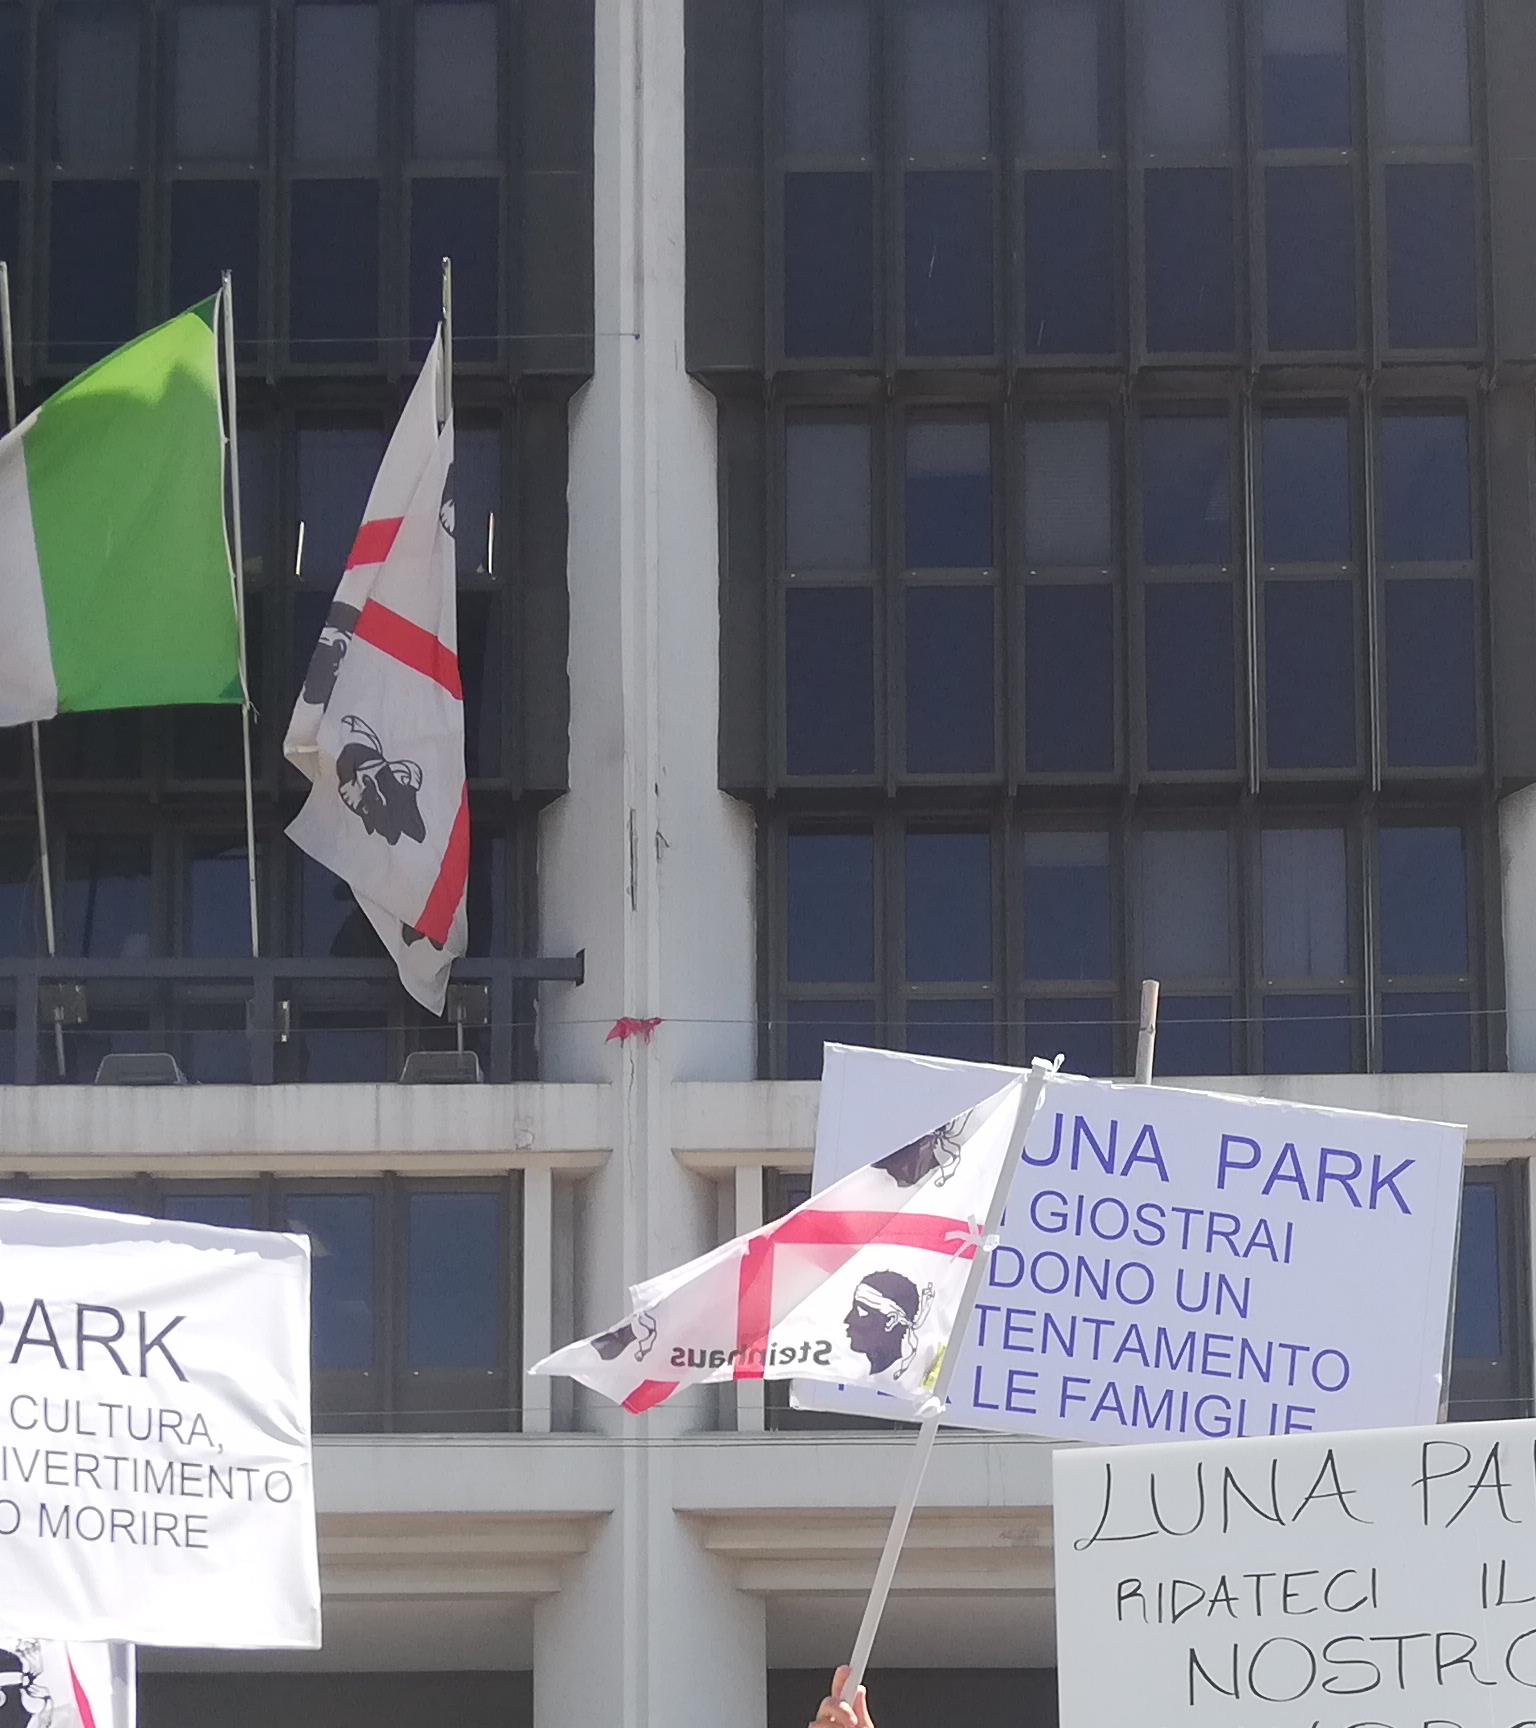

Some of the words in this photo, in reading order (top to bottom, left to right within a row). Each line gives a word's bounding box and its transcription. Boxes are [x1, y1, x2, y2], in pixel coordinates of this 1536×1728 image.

[1020, 1111, 1170, 1183] UNA
[1216, 1132, 1418, 1216] PARK
[1029, 1189, 1294, 1266] GIOSTRAI
[988, 1245, 1156, 1306] DONO
[1174, 1268, 1252, 1320] UN
[973, 1303, 1351, 1394] TENTAMENTO
[9, 1393, 225, 1454] CULTURA,
[972, 1364, 1037, 1415] LE
[1059, 1375, 1317, 1439] FAMIGLIE
[38, 1503, 209, 1550] MORIRE
[1072, 1448, 1374, 1552] LUNA
[1116, 1567, 1377, 1624] RIDATECI
[1479, 1558, 1536, 1611] IL
